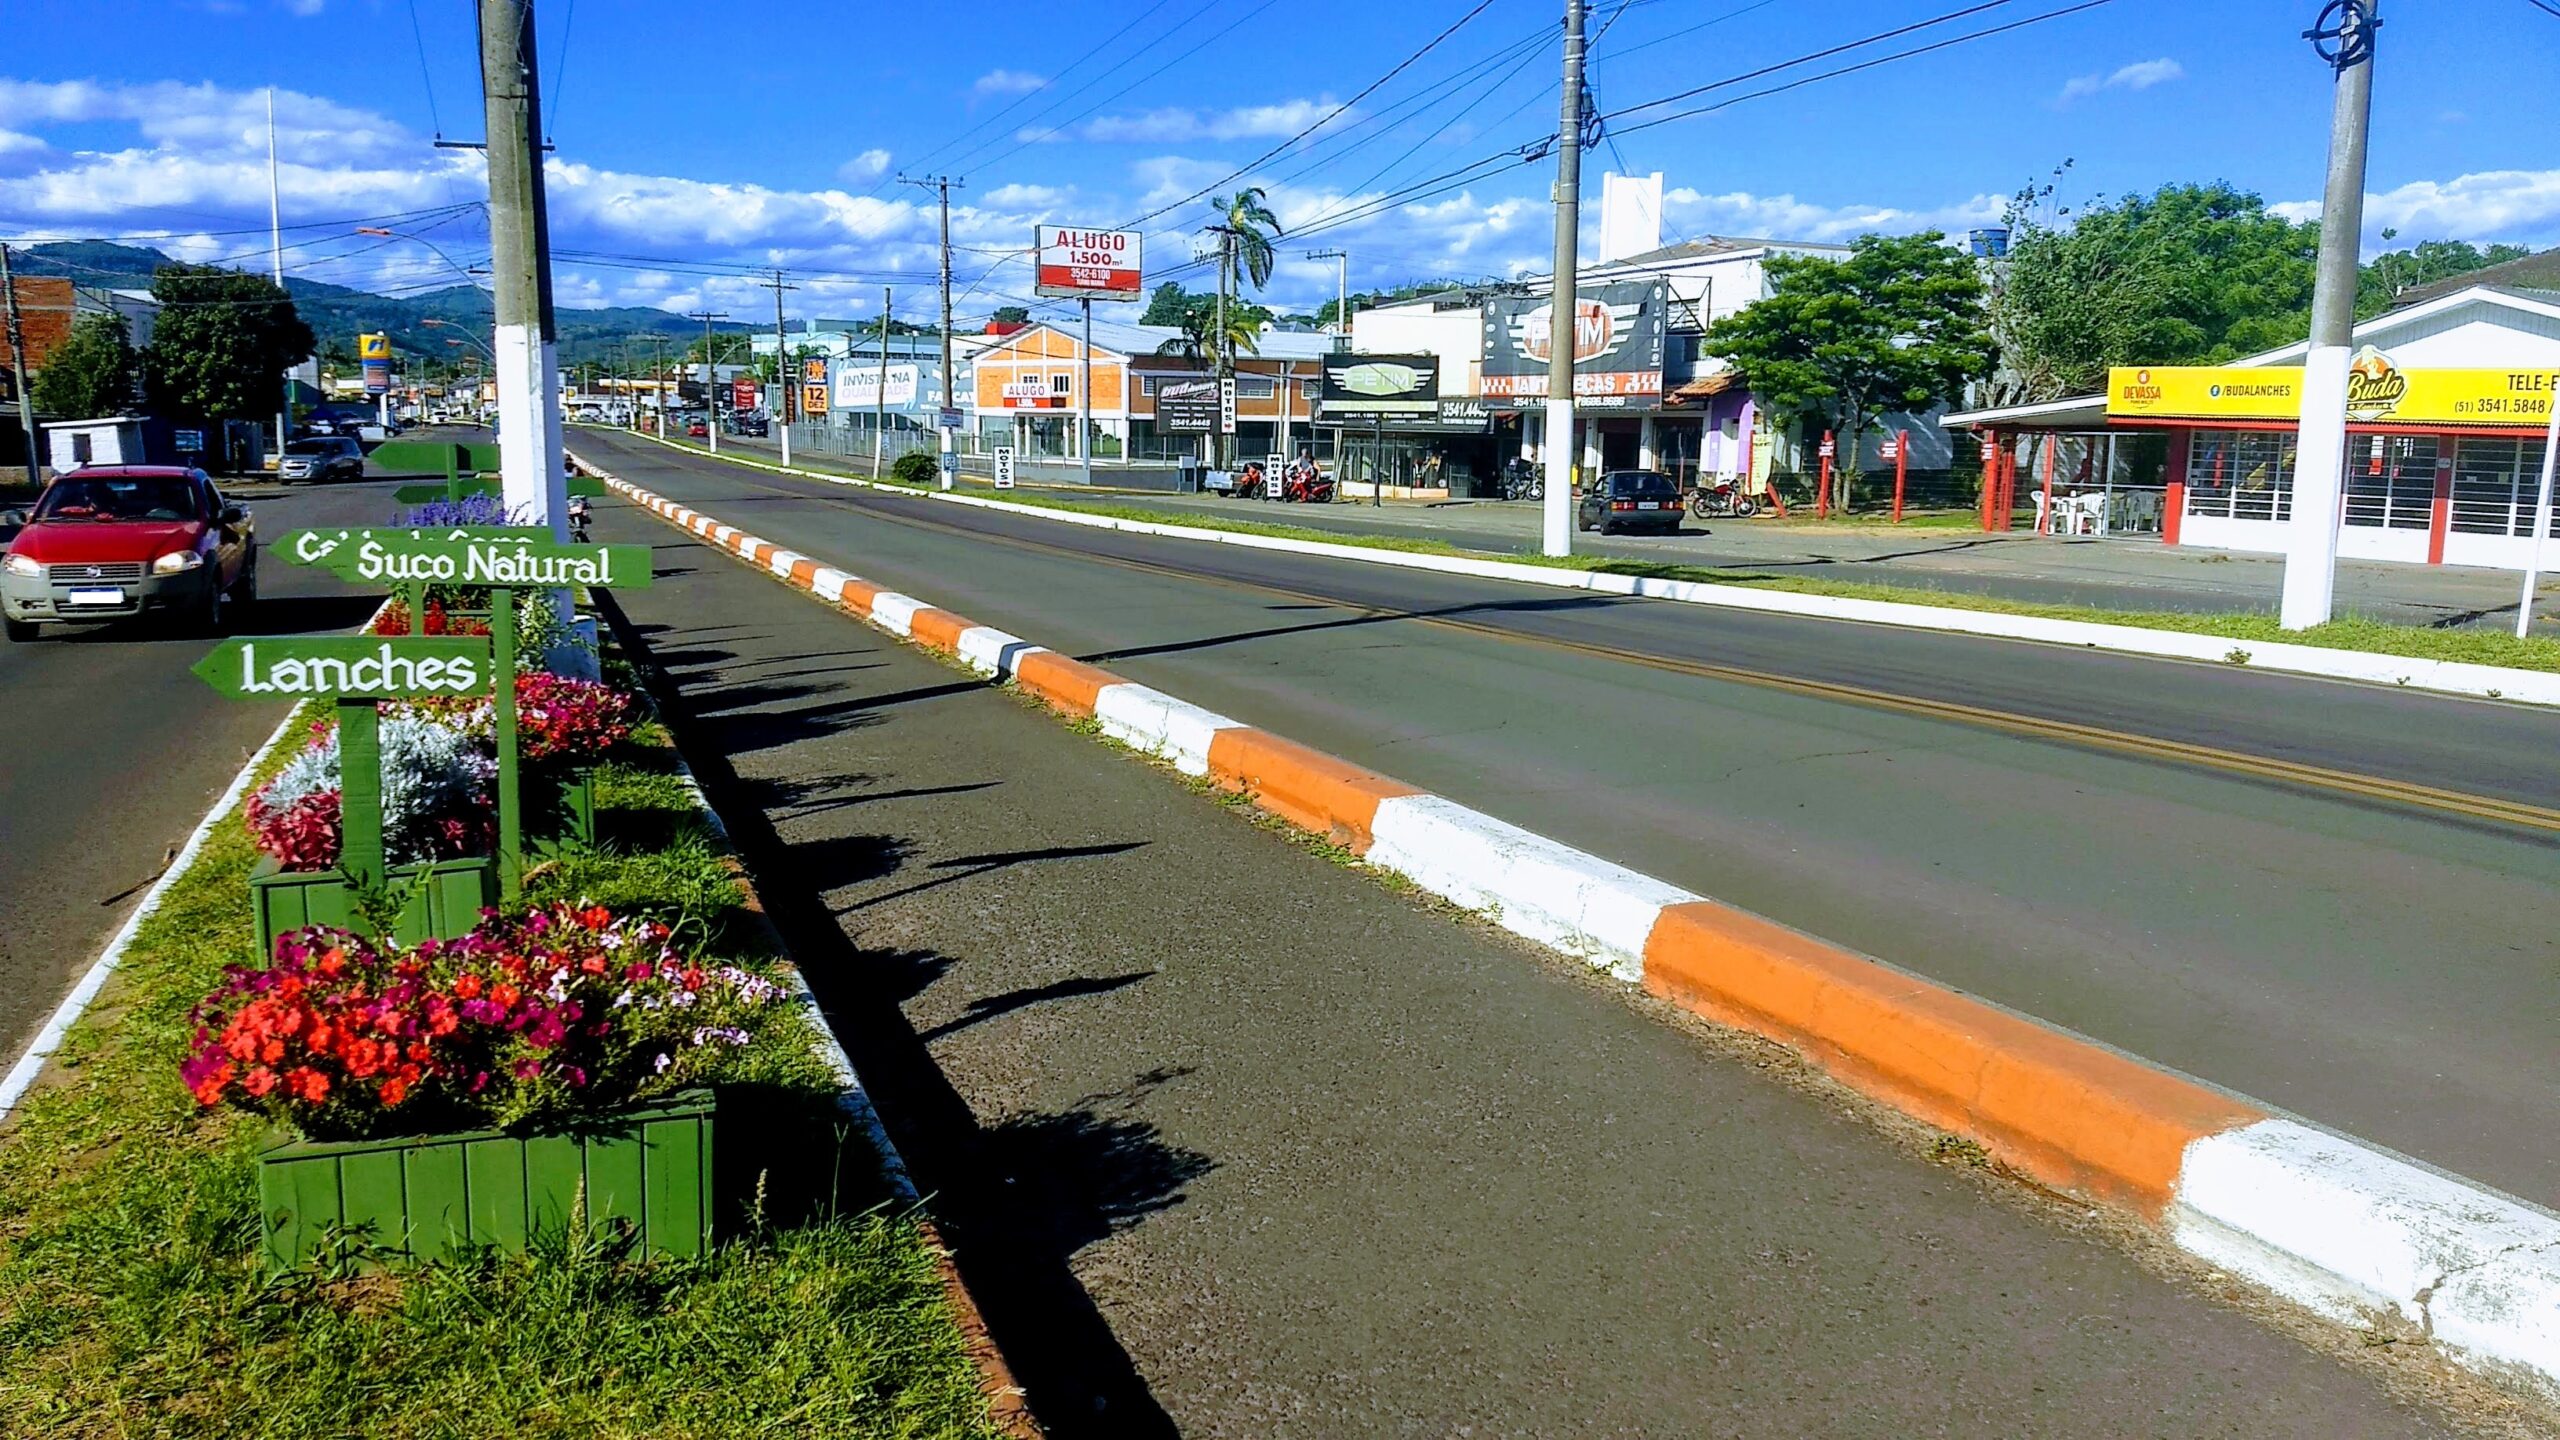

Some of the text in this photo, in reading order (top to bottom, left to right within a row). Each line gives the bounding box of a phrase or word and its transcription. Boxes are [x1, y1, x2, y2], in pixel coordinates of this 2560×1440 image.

[1057, 230, 1125, 251] ALUGO
[1070, 267, 1111, 280] 3542-6100
[1531, 317, 1604, 348] PIM
[893, 372, 911, 384] NA
[1351, 371, 1410, 386] PETIM
[2347, 370, 2402, 402] Buda
[807, 387, 825, 401] 12
[842, 384, 911, 398] QUALIADE
[1008, 385, 1045, 396] ALUGO
[2123, 386, 2161, 400] DEVASSA
[807, 401, 825, 409] DEZ
[1224, 382, 1233, 421] MOTOS
[2454, 401, 2474, 413] (51)
[2477, 398, 2545, 414] 3541.5848
[998, 449, 1010, 480] MOTOS
[1270, 457, 1279, 488] MOTOS
[357, 541, 455, 580] Suco
[462, 544, 614, 585] Natural
[240, 642, 477, 694] Lanches
